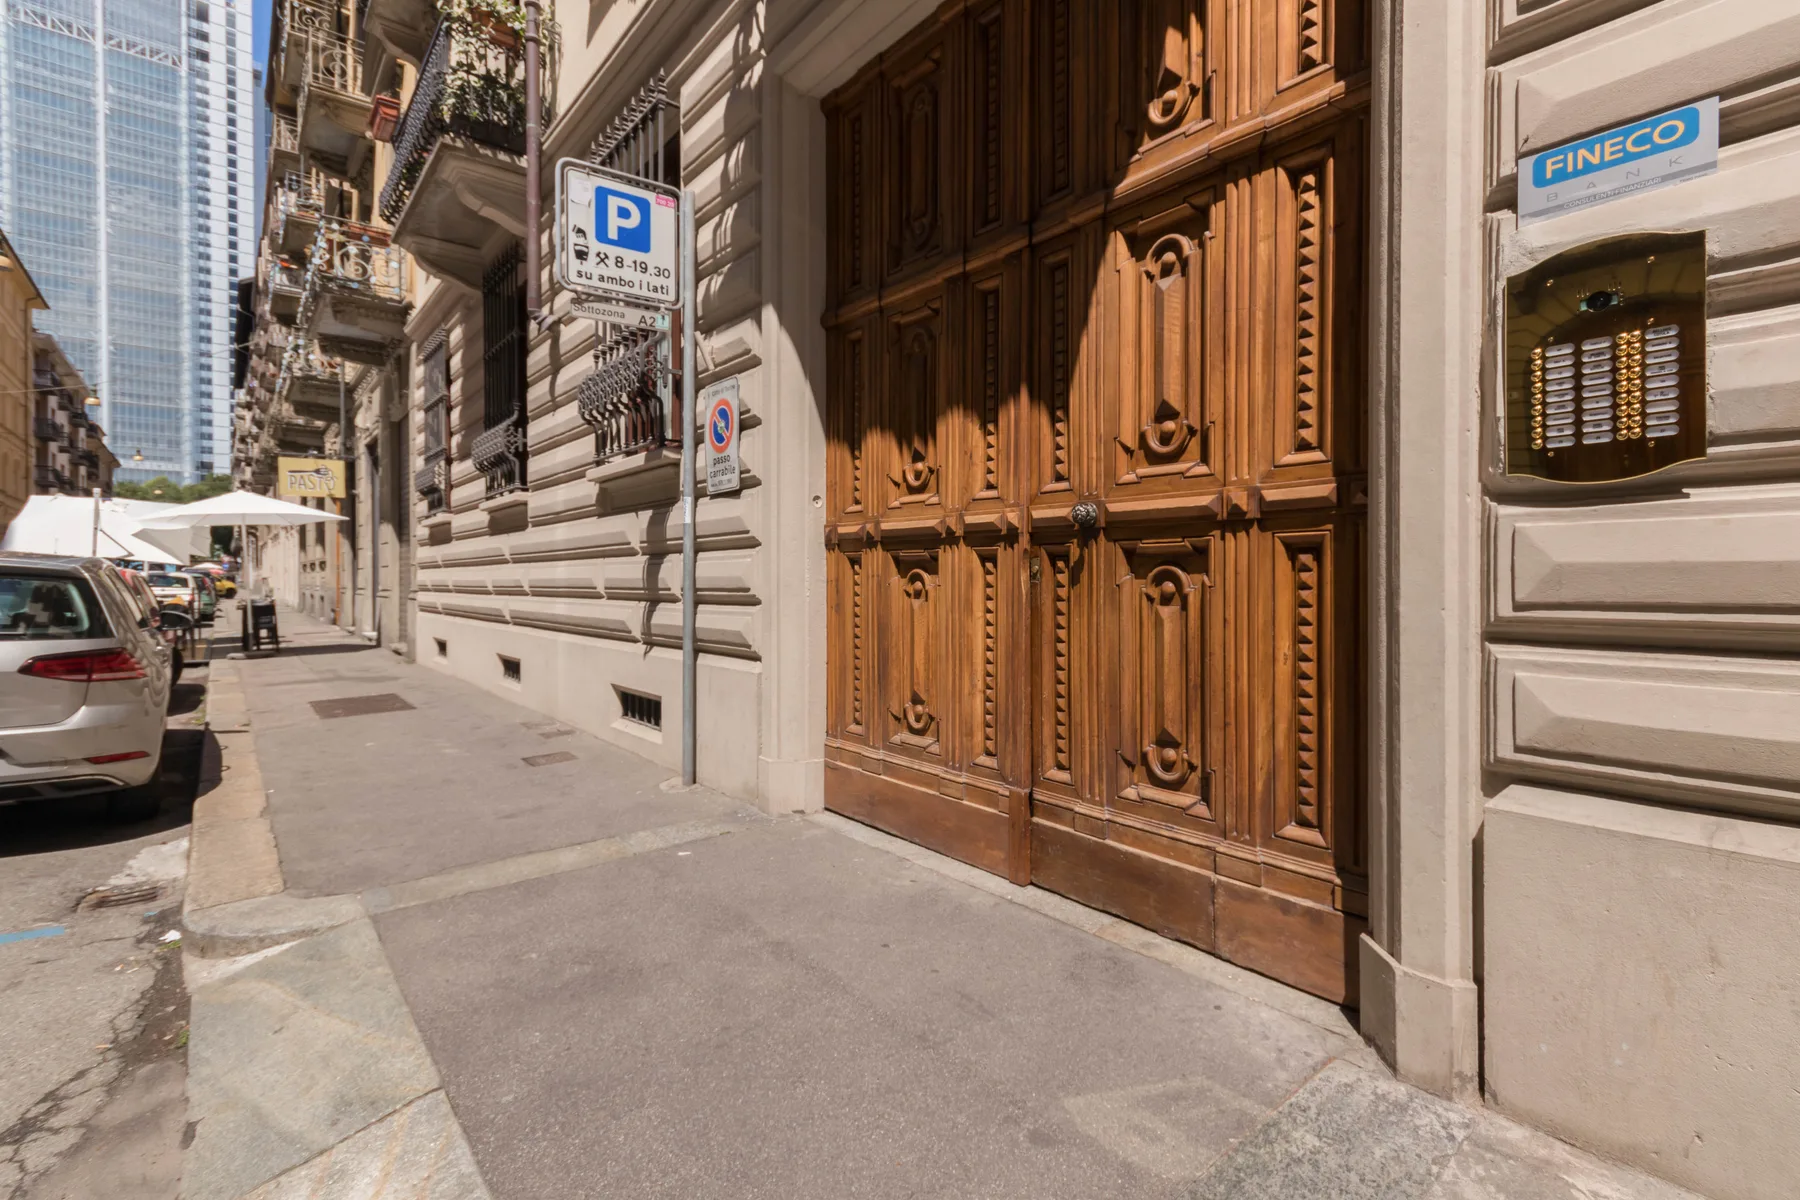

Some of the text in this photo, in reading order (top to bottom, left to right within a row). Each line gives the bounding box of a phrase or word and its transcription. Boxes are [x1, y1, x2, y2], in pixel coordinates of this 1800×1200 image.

[1545, 119, 1685, 179] FINECO
[1563, 191, 1614, 209] CONSULENTI
[1614, 177, 1662, 196] FINANZIARI
[607, 194, 641, 241] P
[614, 256, 671, 279] 8-19.30
[576, 269, 669, 296] su ambo i lati
[573, 302, 656, 328] Sottozona A2
[709, 465, 736, 479] carrabile
[713, 454, 731, 467] passo
[287, 474, 336, 492] PASTO
